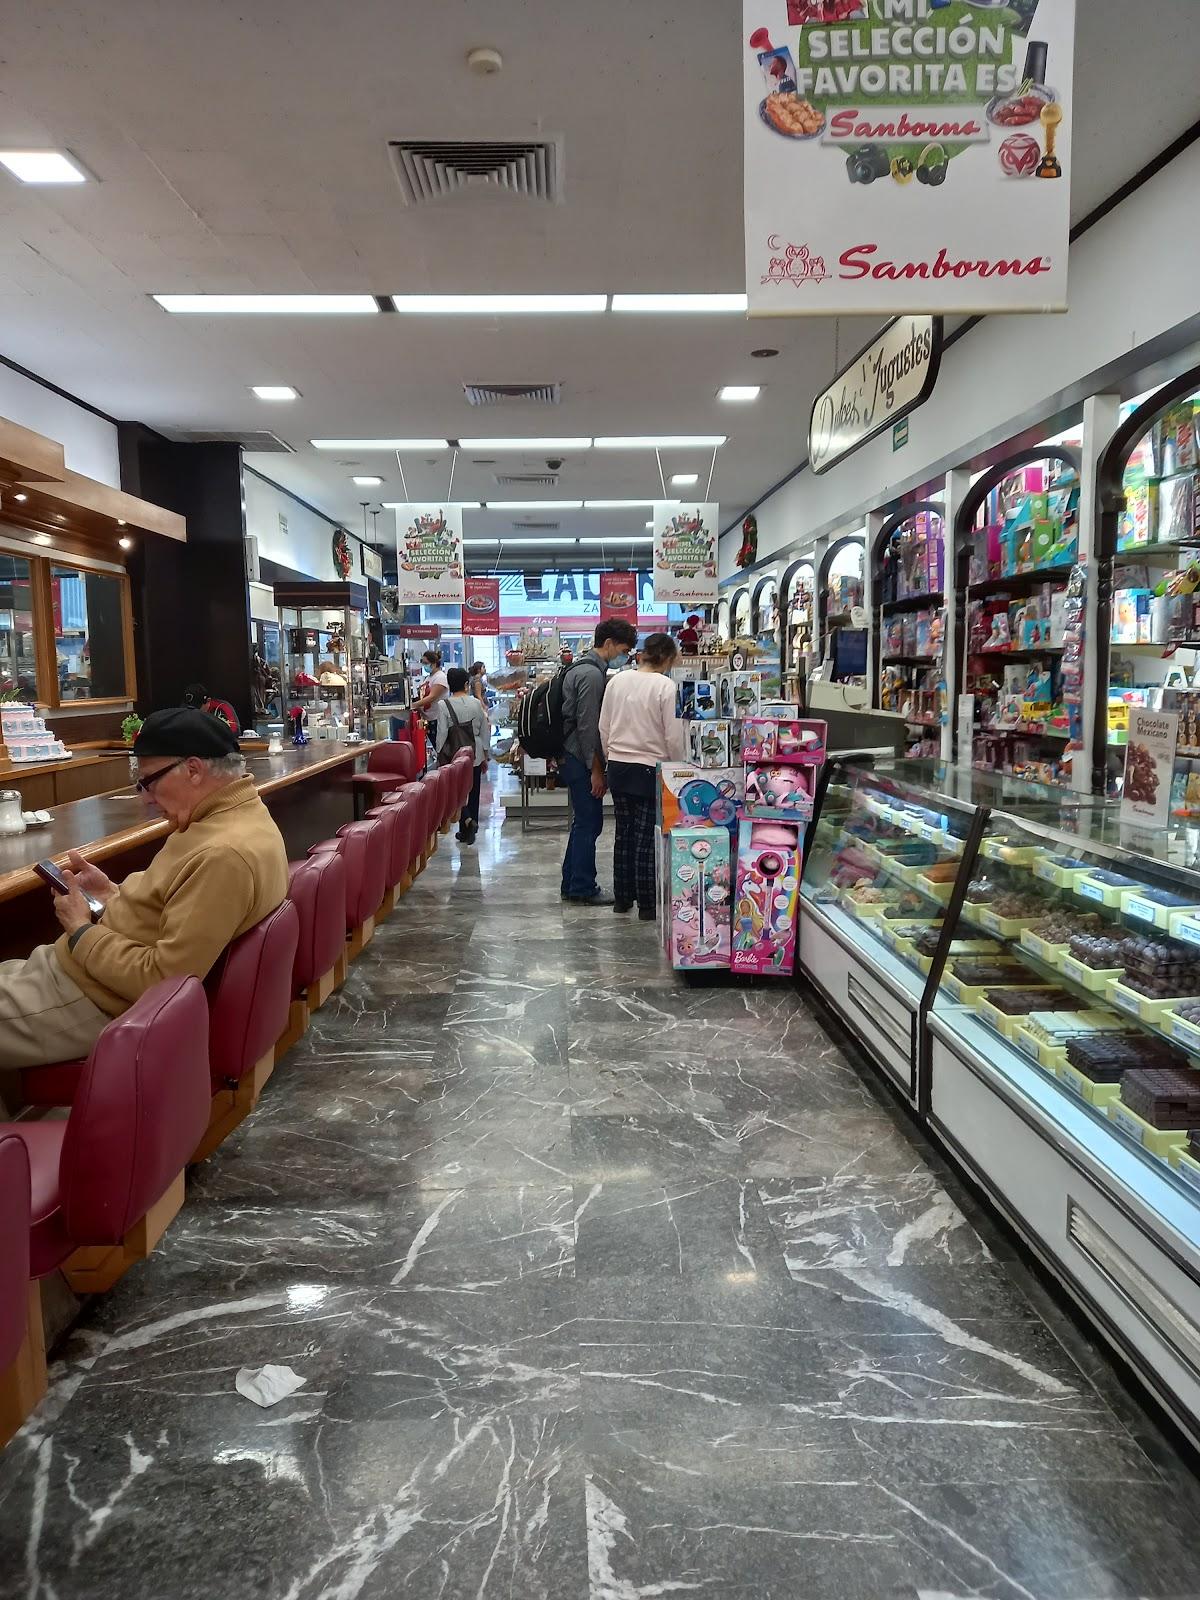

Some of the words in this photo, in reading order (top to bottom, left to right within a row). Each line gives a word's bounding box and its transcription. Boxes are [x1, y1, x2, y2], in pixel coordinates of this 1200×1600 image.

[884, 0, 928, 19] MI
[808, 14, 1005, 59] SELECCIÓN
[798, 64, 967, 96] FAVORITA
[975, 64, 1017, 94] ES
[830, 110, 981, 139] Sanborns
[838, 244, 1051, 281] Sanborns
[864, 322, 931, 428] Juguetes
[411, 546, 451, 556] SELECCIÓN
[418, 590, 460, 598] Sanborns
[672, 589, 714, 597] Sanborns
[1136, 717, 1169, 730] Chocolate
[1136, 726, 1168, 739] Mexicano
[734, 951, 759, 964] Barbie
